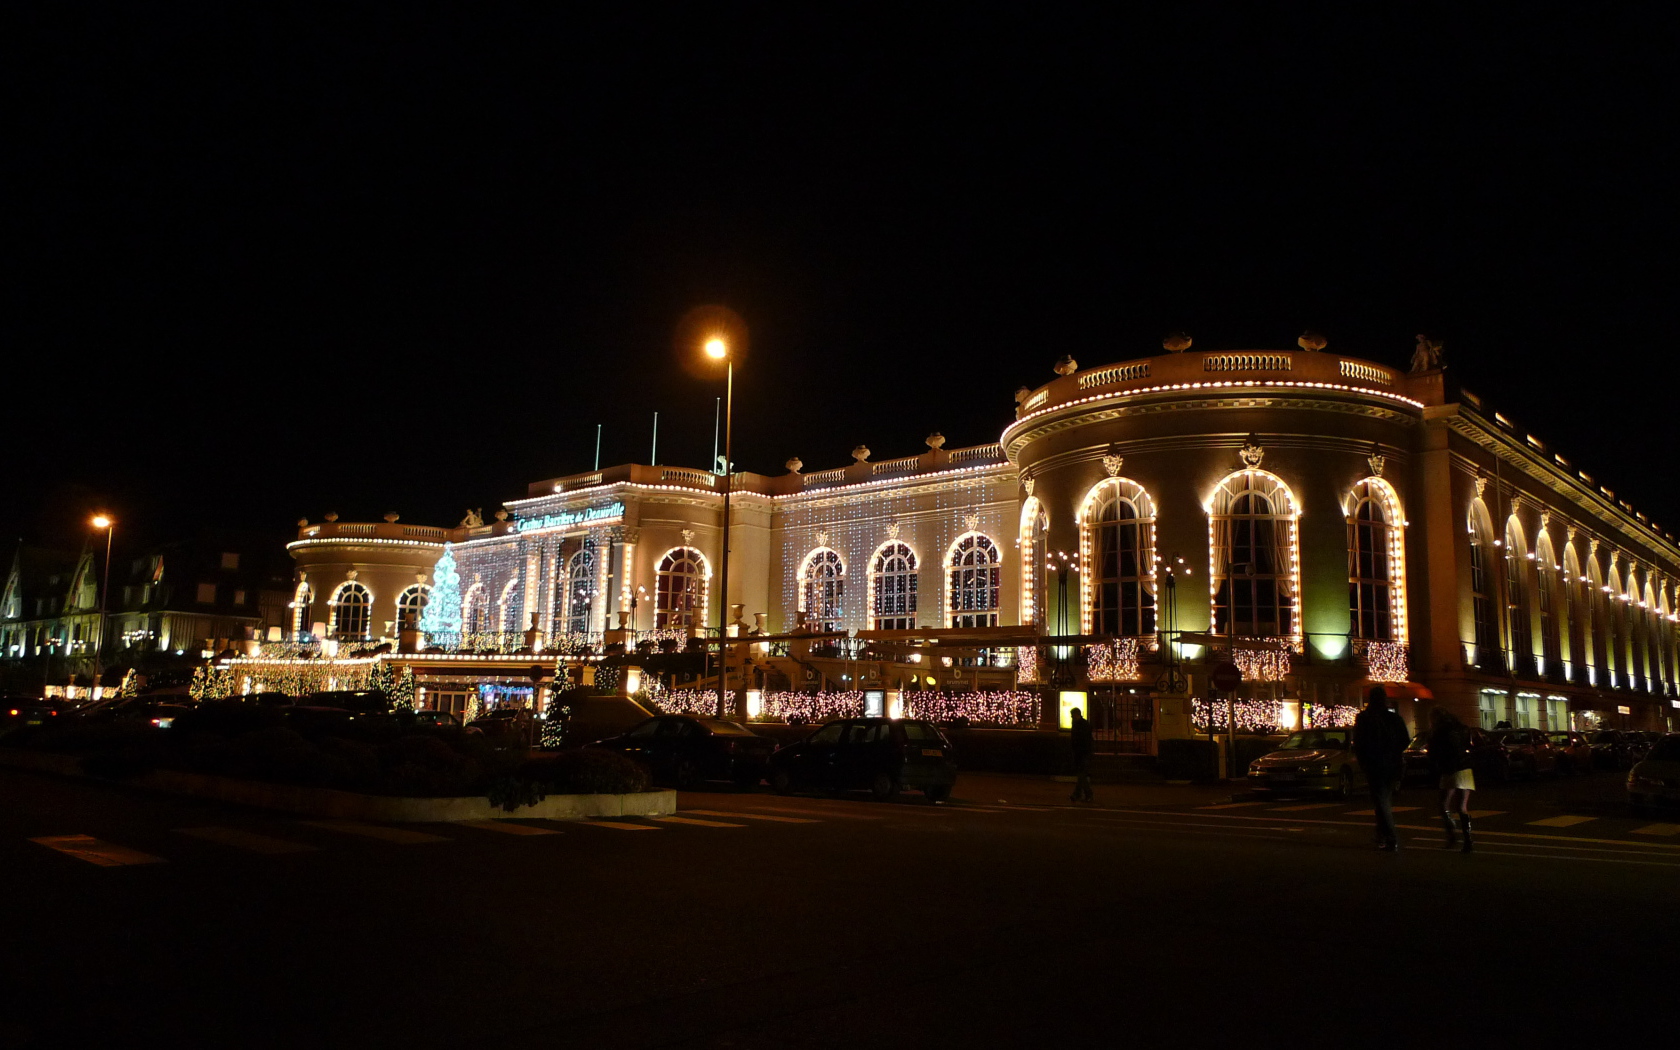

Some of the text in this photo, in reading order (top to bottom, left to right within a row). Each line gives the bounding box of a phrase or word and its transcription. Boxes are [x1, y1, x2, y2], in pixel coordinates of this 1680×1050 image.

[517, 517, 544, 532] Casino
[575, 511, 584, 523] de
[584, 502, 625, 521] Deauville
